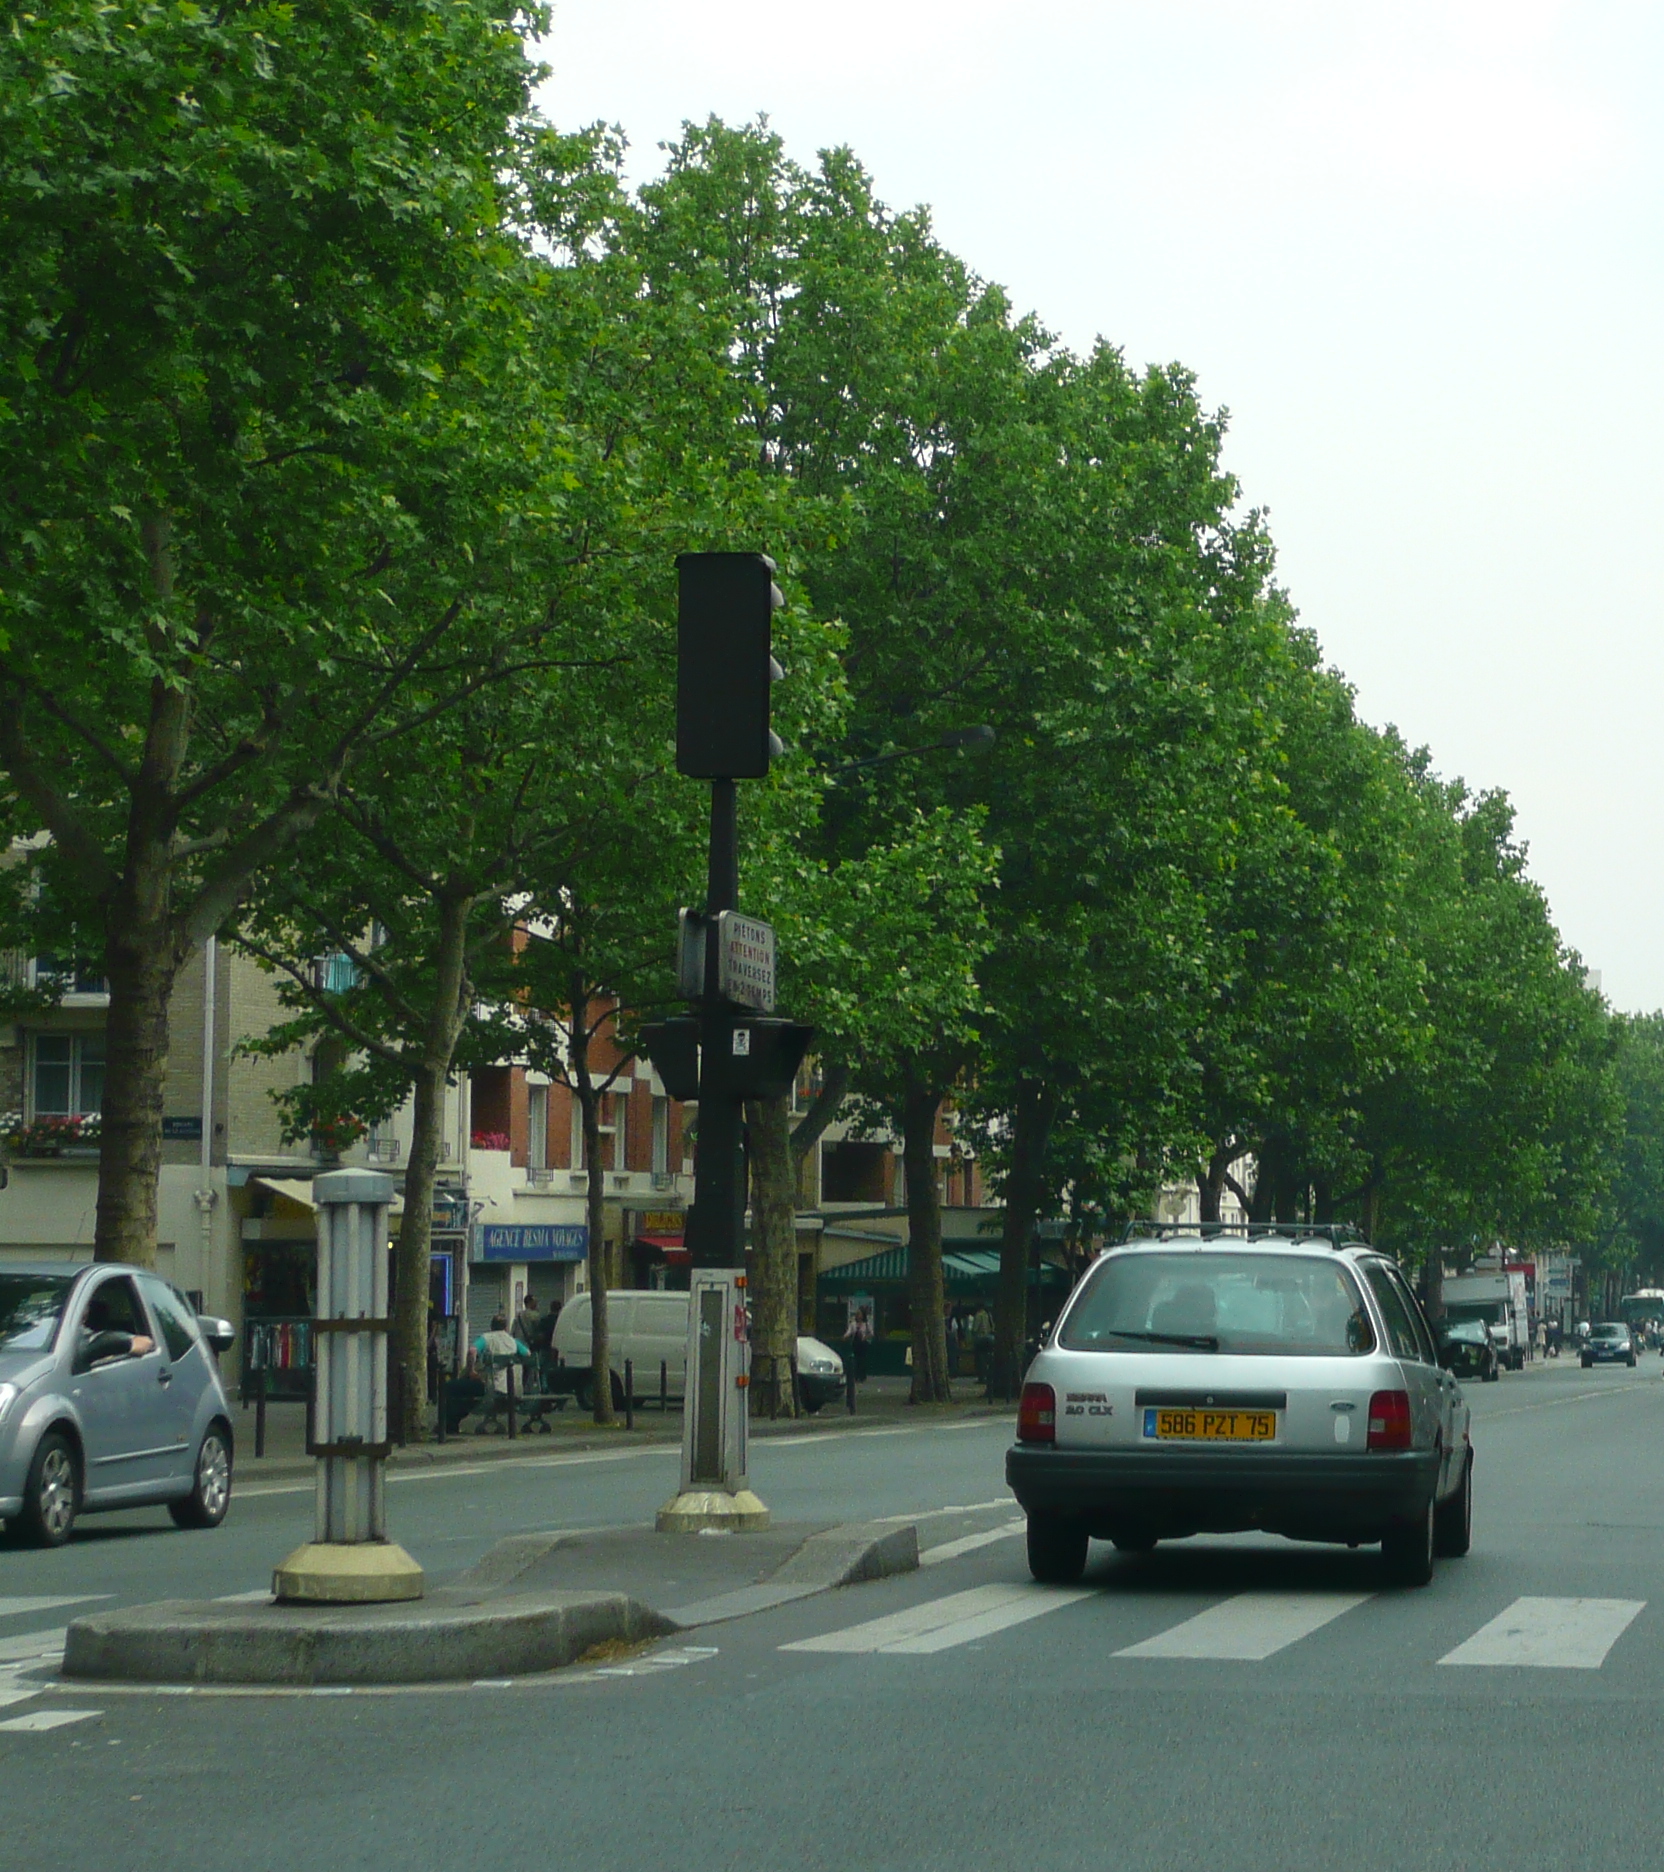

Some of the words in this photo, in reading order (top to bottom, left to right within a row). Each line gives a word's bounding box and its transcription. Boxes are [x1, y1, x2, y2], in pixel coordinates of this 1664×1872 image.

[730, 940, 771, 966] ATTENTION
[727, 957, 772, 985] TRAVERSEZ
[489, 1228, 521, 1248] AGENCE
[552, 1227, 584, 1247] VOYAGES
[1160, 1413, 1197, 1435] 586
[1202, 1414, 1239, 1435] PZT
[1245, 1414, 1270, 1436] 75
